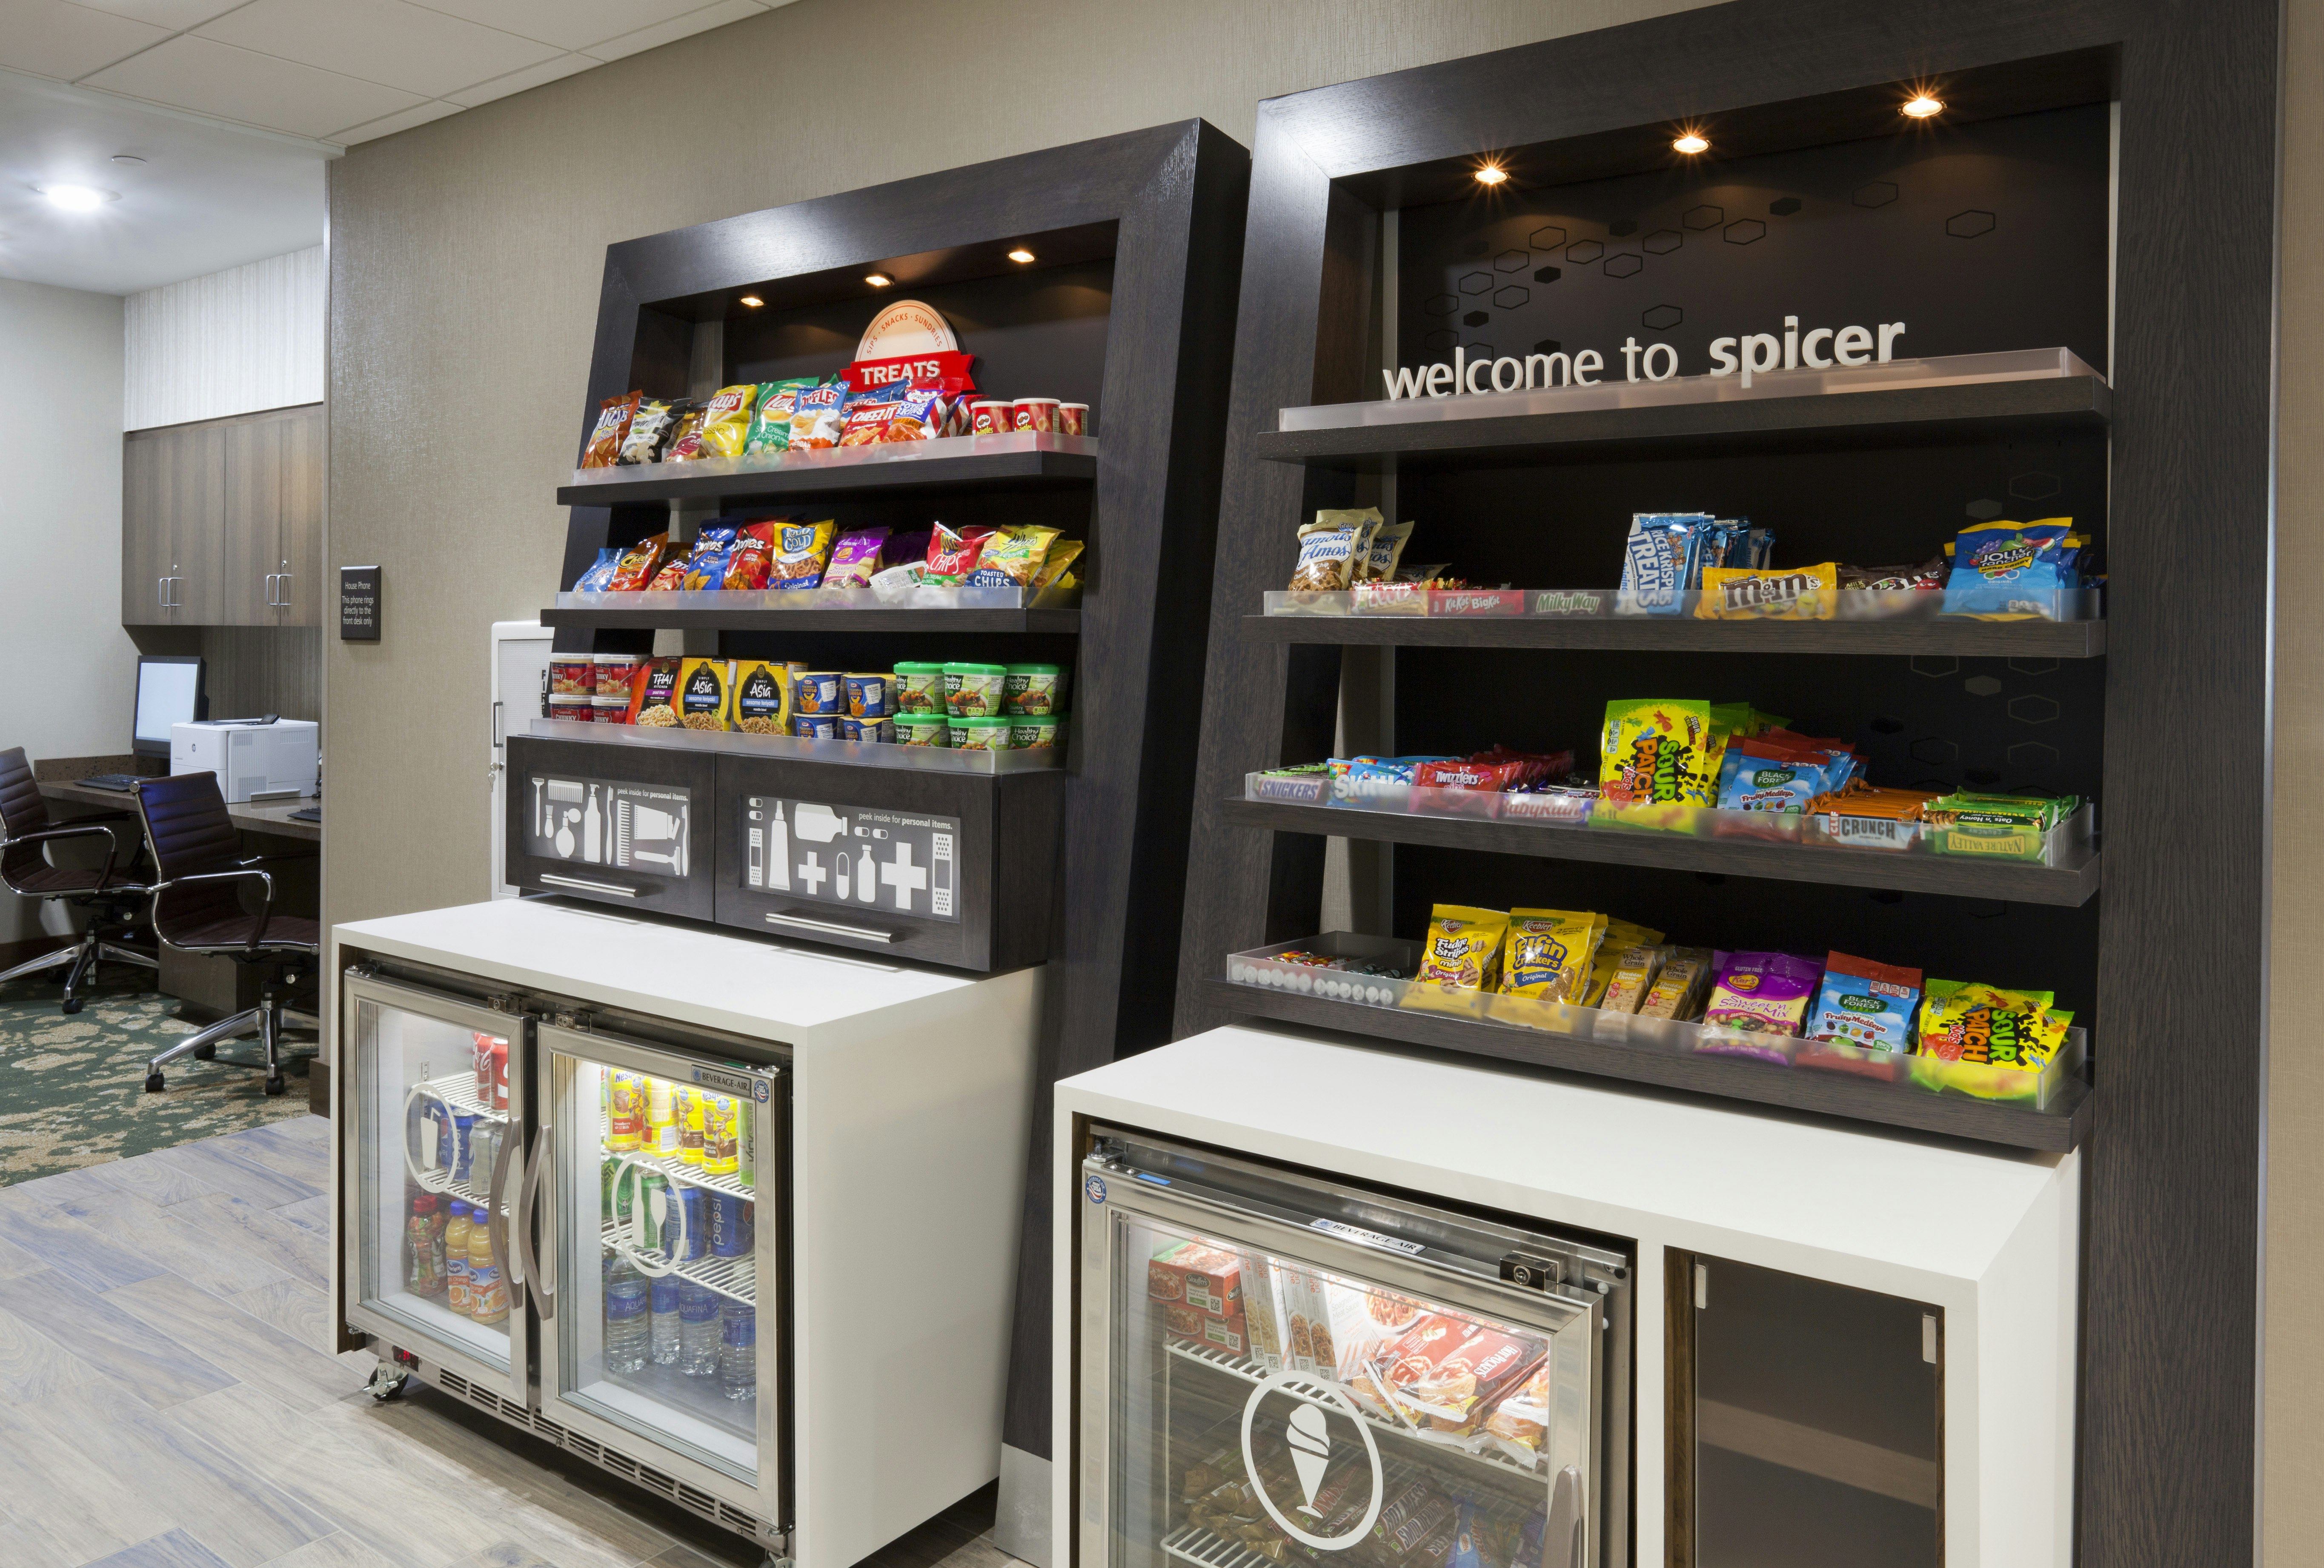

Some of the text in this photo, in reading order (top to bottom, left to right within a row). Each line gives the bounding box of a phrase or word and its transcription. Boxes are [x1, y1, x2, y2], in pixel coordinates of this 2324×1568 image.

[867, 313, 942, 355] SIPS SNACKS SUNDRIES
[1383, 315, 1906, 401] welcome to spicer
[861, 361, 940, 385] TREATS
[896, 408, 925, 416] SKINS
[761, 432, 780, 441] Onion
[767, 425, 789, 438] Cream
[784, 535, 810, 551] GOLD
[1651, 530, 1665, 550] RICE
[1298, 546, 1348, 567] Amos
[1981, 546, 2032, 562] JOLLY
[1982, 550, 2032, 566] rancher
[930, 553, 961, 575] CHIPS
[975, 576, 1010, 587] CHIPS
[981, 570, 1004, 578] TOASTED
[784, 580, 809, 589] Original
[1846, 581, 1863, 589] MILK
[350, 596, 363, 605] phone
[364, 596, 374, 606] rings
[344, 606, 358, 616] directly
[343, 616, 353, 624] front
[363, 617, 372, 627] only
[653, 674, 673, 684] THAI
[945, 675, 961, 684] Healthy
[693, 680, 712, 694] Asia
[750, 683, 770, 698] Asia
[1691, 716, 1701, 734] SOUR
[1436, 770, 1479, 785] Twizzlers
[1622, 766, 1635, 790] Kids
[1633, 738, 1657, 803] PATCH
[1654, 741, 1680, 800] SOUR
[650, 790, 672, 800] personal
[673, 793, 688, 801] items.
[1261, 780, 1319, 800] SNICKERS
[1741, 792, 1765, 802] Fruity
[859, 813, 953, 830] peek inside for personal items.
[1831, 811, 1896, 840] CLIF CRUNCH
[1950, 834, 2022, 852] NATURE VALLEY
[1441, 920, 1463, 928] Keebler
[1523, 921, 1553, 931] Keebler
[1435, 944, 1469, 958] Stripes
[1438, 938, 1467, 950] Fudge
[1517, 935, 1566, 959] Elfin
[1440, 959, 1462, 967] minis
[1514, 954, 1560, 969] crackers
[1436, 970, 1460, 979] Original
[1522, 973, 1546, 981] Original
[1732, 976, 1756, 985] Kar's
[1730, 996, 1772, 1007] Sweet
[1844, 1000, 1882, 1009] FOREST
[1849, 996, 1880, 1004] BLACK
[1719, 999, 1788, 1018] Salty Mix
[1825, 1013, 1886, 1032] Fruity Medleys
[1949, 1025, 1965, 1044] Kids
[1962, 1007, 1991, 1062] PATCH
[1989, 1009, 2018, 1061] SOUR
[702, 1073, 747, 1091] BEVERAGE-AIR
[713, 1197, 724, 1245] pepsi
[1333, 1224, 1417, 1251] BEVERAGE-AIR
[1188, 1275, 1208, 1286] Stouffer's
[1332, 1296, 1352, 1311] Spaghetti
[1333, 1301, 1359, 1320] Meat Sauce
[1474, 1345, 1518, 1377] HOT POCKETS
